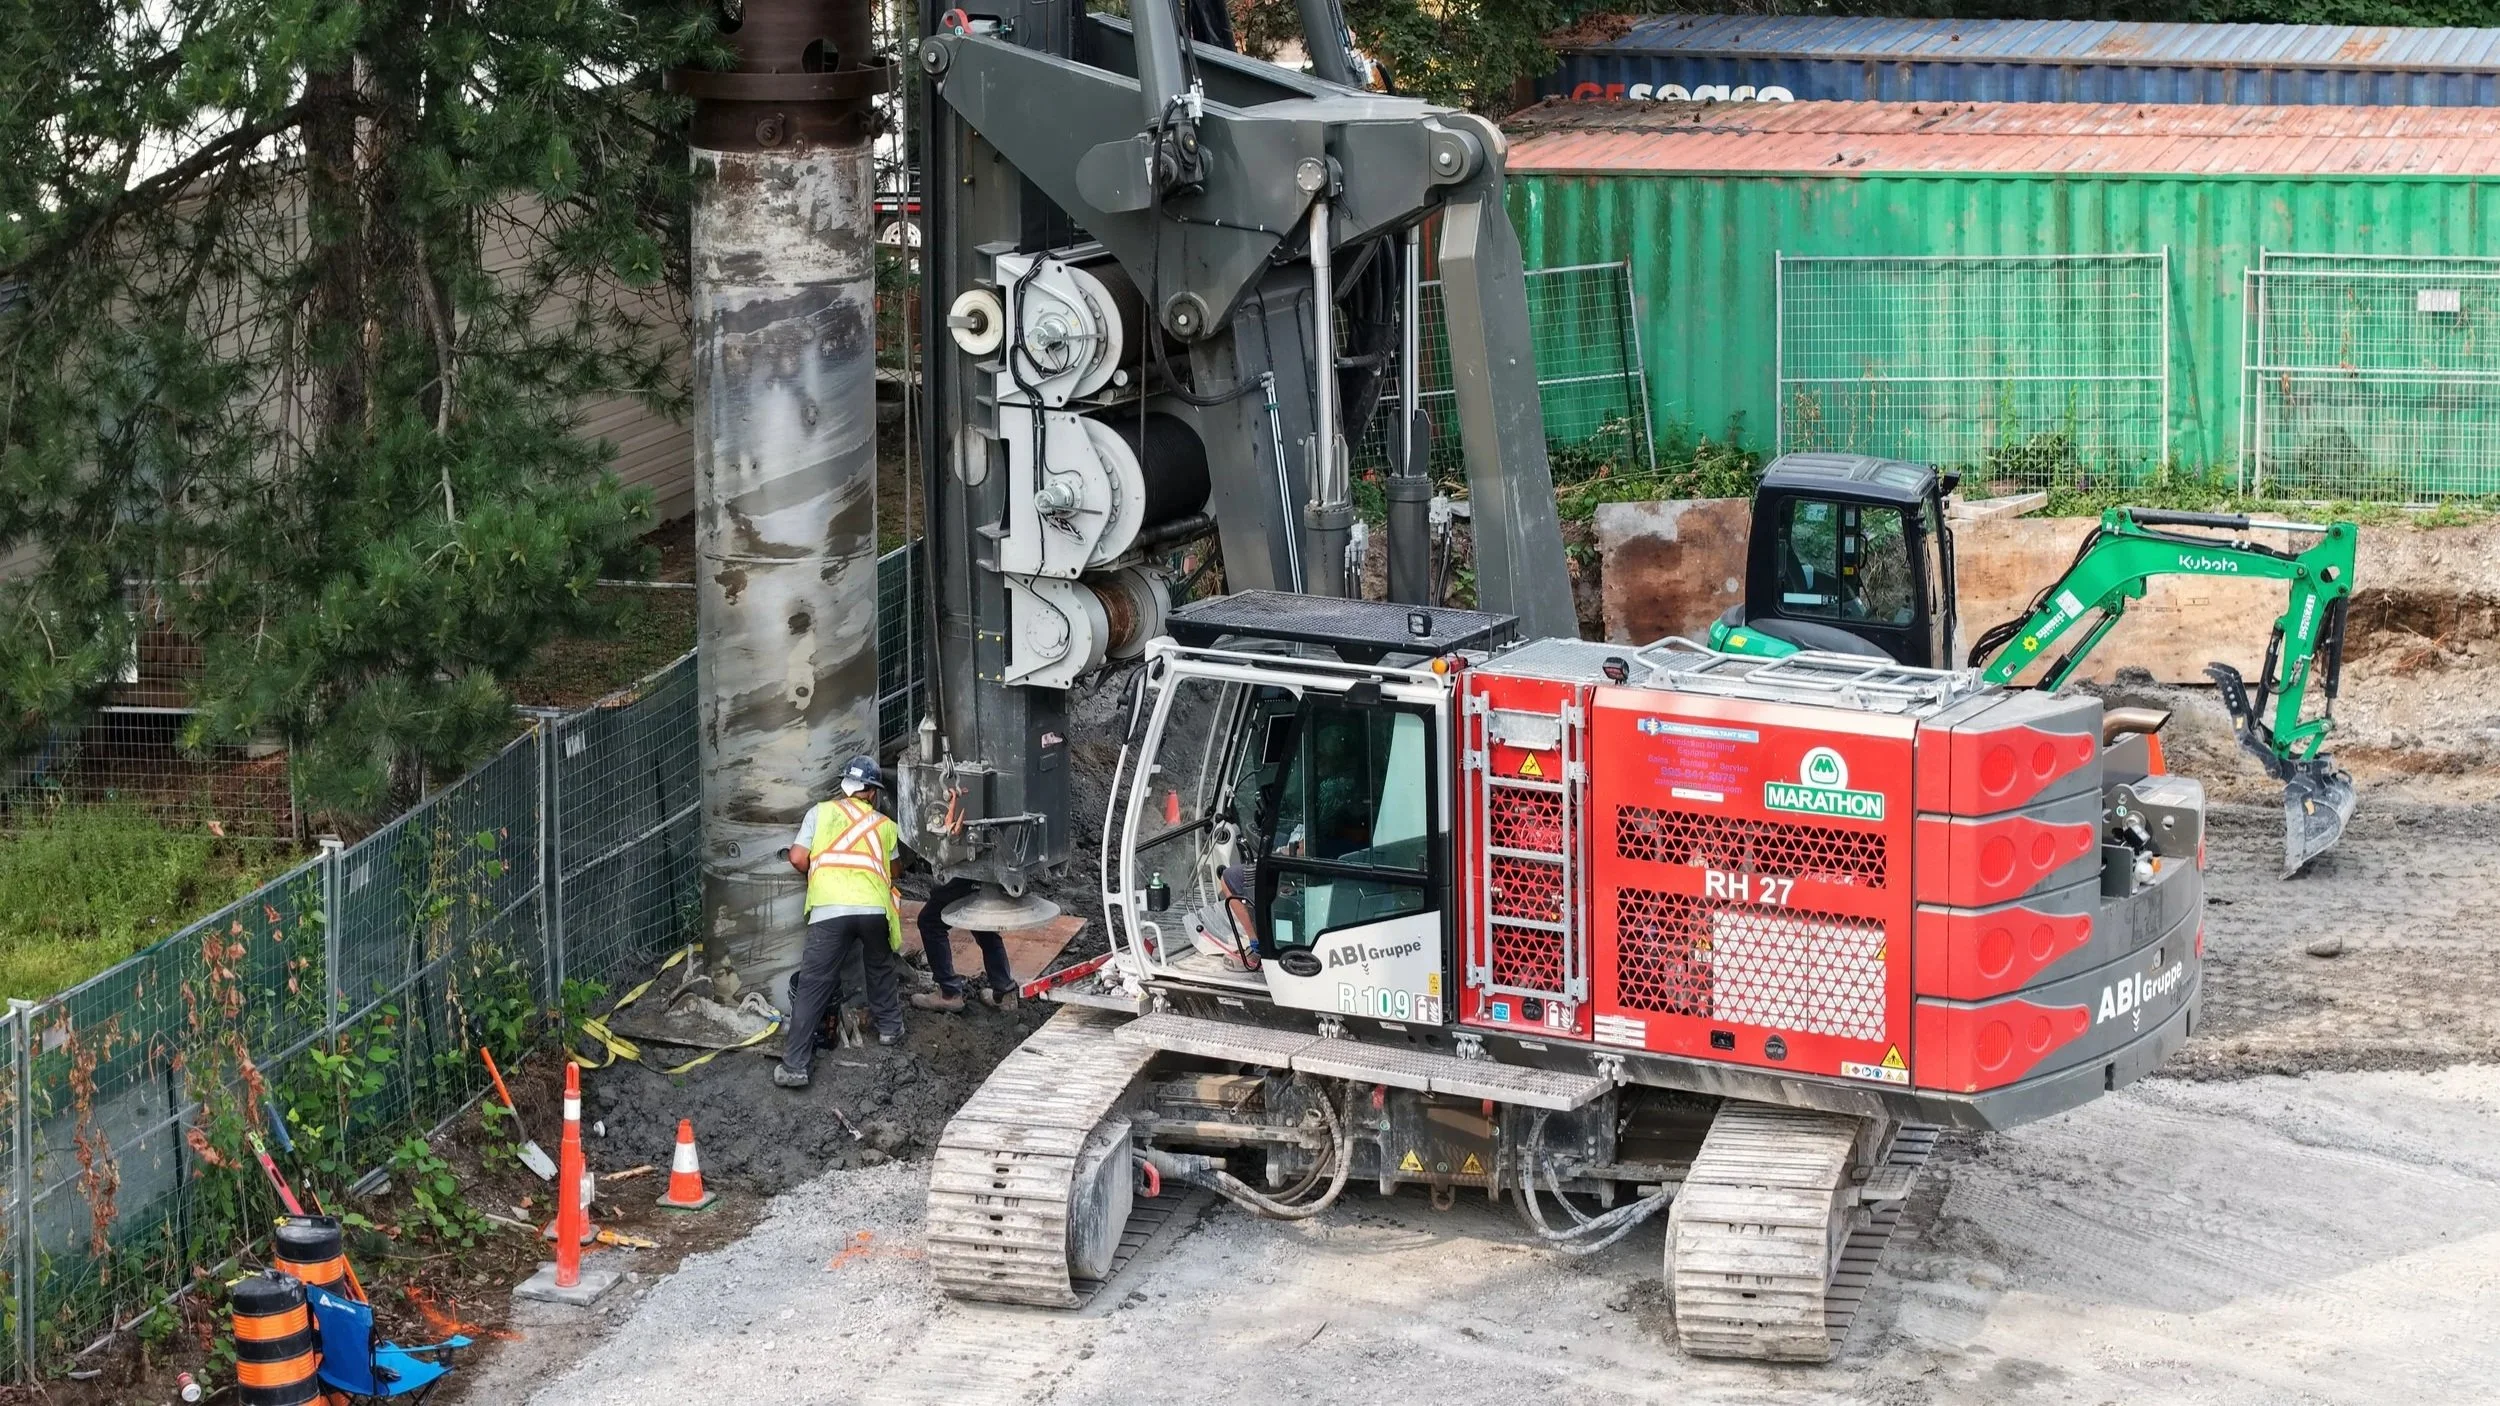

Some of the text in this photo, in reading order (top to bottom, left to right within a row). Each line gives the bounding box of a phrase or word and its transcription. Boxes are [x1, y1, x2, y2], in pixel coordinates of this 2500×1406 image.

[2178, 554, 2238, 572] Kubota
[1768, 786, 1882, 817] MARATHON
[1705, 870, 1795, 905] RH 27
[1328, 941, 1422, 969] ABI Gruppe
[1338, 982, 1411, 1020] R 109
[2096, 971, 2141, 1025] ABI
[2142, 961, 2183, 1003] Gruppe
